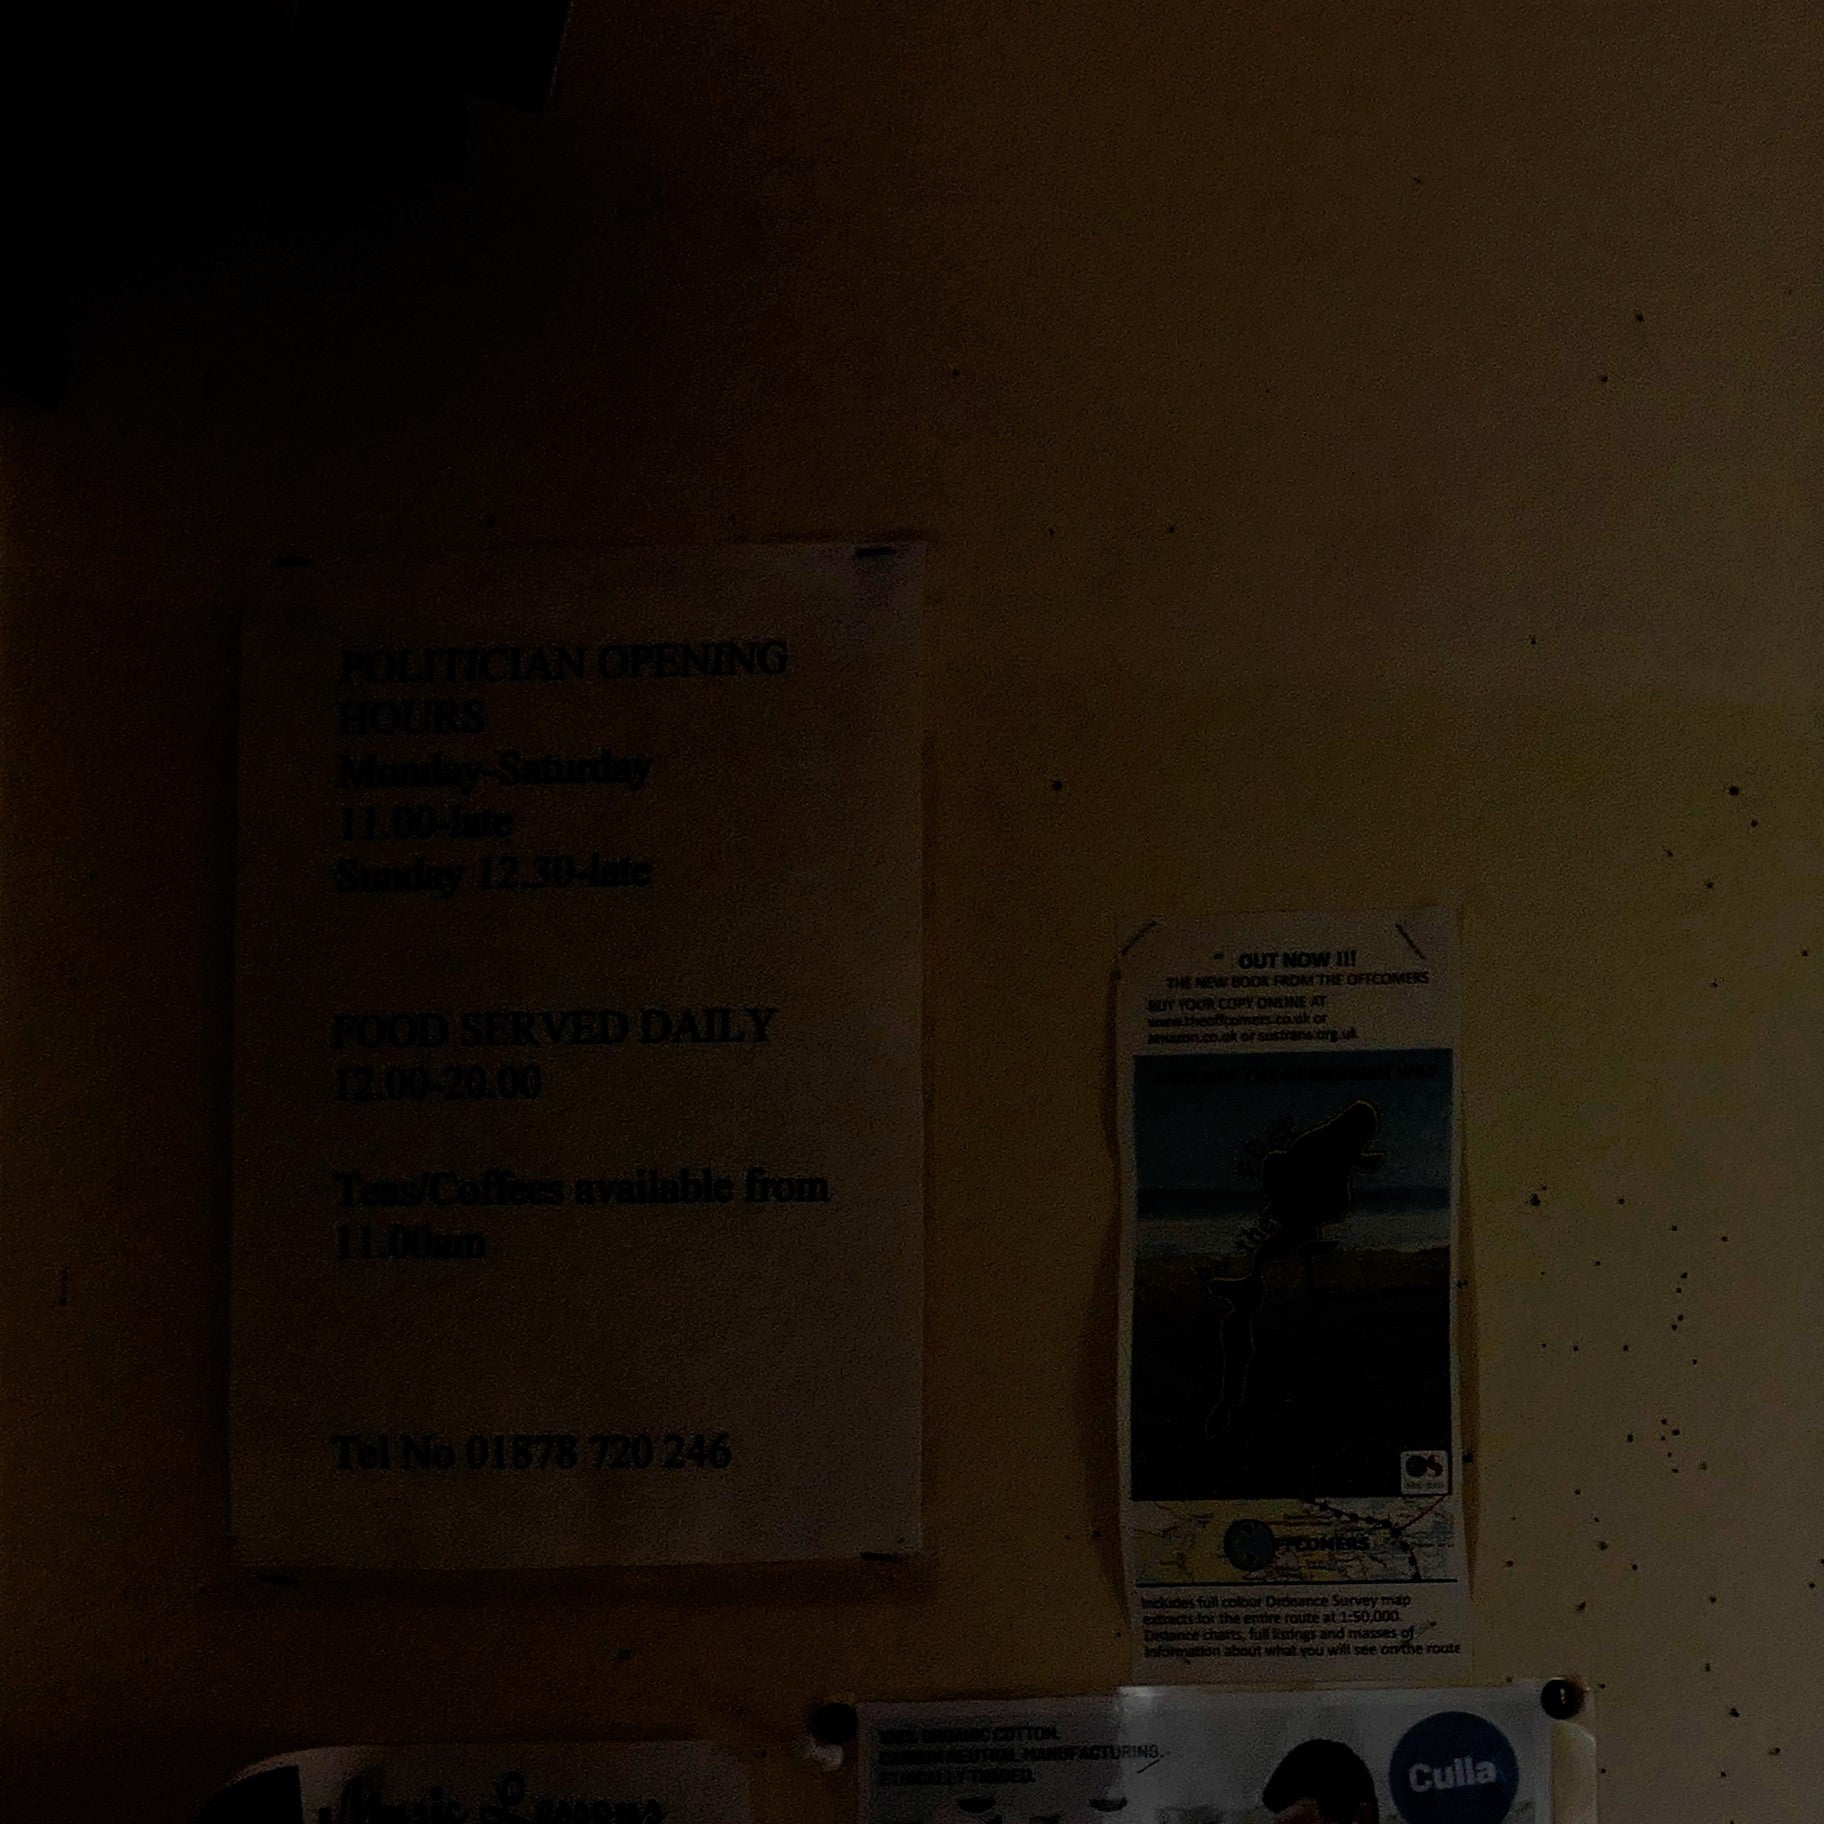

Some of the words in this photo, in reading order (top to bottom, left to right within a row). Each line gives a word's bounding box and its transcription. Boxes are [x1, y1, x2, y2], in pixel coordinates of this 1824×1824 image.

[340, 645, 584, 683] POLITICIAN
[599, 641, 788, 678] OPENING
[339, 699, 486, 735] HOURS
[338, 749, 653, 794] Monday-Saturday
[340, 806, 514, 840] 11.00-late
[335, 857, 464, 898] Sunday
[481, 854, 652, 889] 12.30-late
[1239, 953, 1277, 968] OUT
[1283, 952, 1330, 968] NOW
[1167, 977, 1190, 989] THE
[1195, 977, 1228, 989] NEW
[1232, 976, 1269, 988] BOOK
[1273, 975, 1314, 987] FROM
[1319, 974, 1343, 986] THE
[1346, 971, 1430, 985] OFFCOMERS
[333, 1013, 448, 1049] FOOD
[460, 1010, 629, 1046] SERVED
[641, 1007, 778, 1043] DAILY
[336, 1064, 543, 1100] 12.00-20.00
[334, 1170, 564, 1207] Teas/Coffees
[575, 1168, 733, 1204] available
[746, 1168, 831, 1202] from
[336, 1224, 486, 1260] 11.00am
[334, 1434, 390, 1470] Tel
[400, 1435, 455, 1470] No
[467, 1435, 578, 1470] 01878
[592, 1434, 653, 1469] 720
[664, 1433, 733, 1469] 246
[1285, 1611, 1319, 1624] route
[1322, 1612, 1337, 1623] at
[1333, 1595, 1378, 1610] Survey
[1381, 1596, 1411, 1609] map
[922, 1727, 990, 1742] ORGANIC
[994, 1727, 1061, 1741] COTTON.
[880, 1751, 946, 1765] CARBON
[950, 1748, 1019, 1763] NEUTRAL
[1024, 1745, 1165, 1761] MANUFACTURING.
[880, 1770, 964, 1786] ETHICALLY
[970, 1769, 1036, 1784] TRADED.
[1408, 1755, 1497, 1793] Culla
